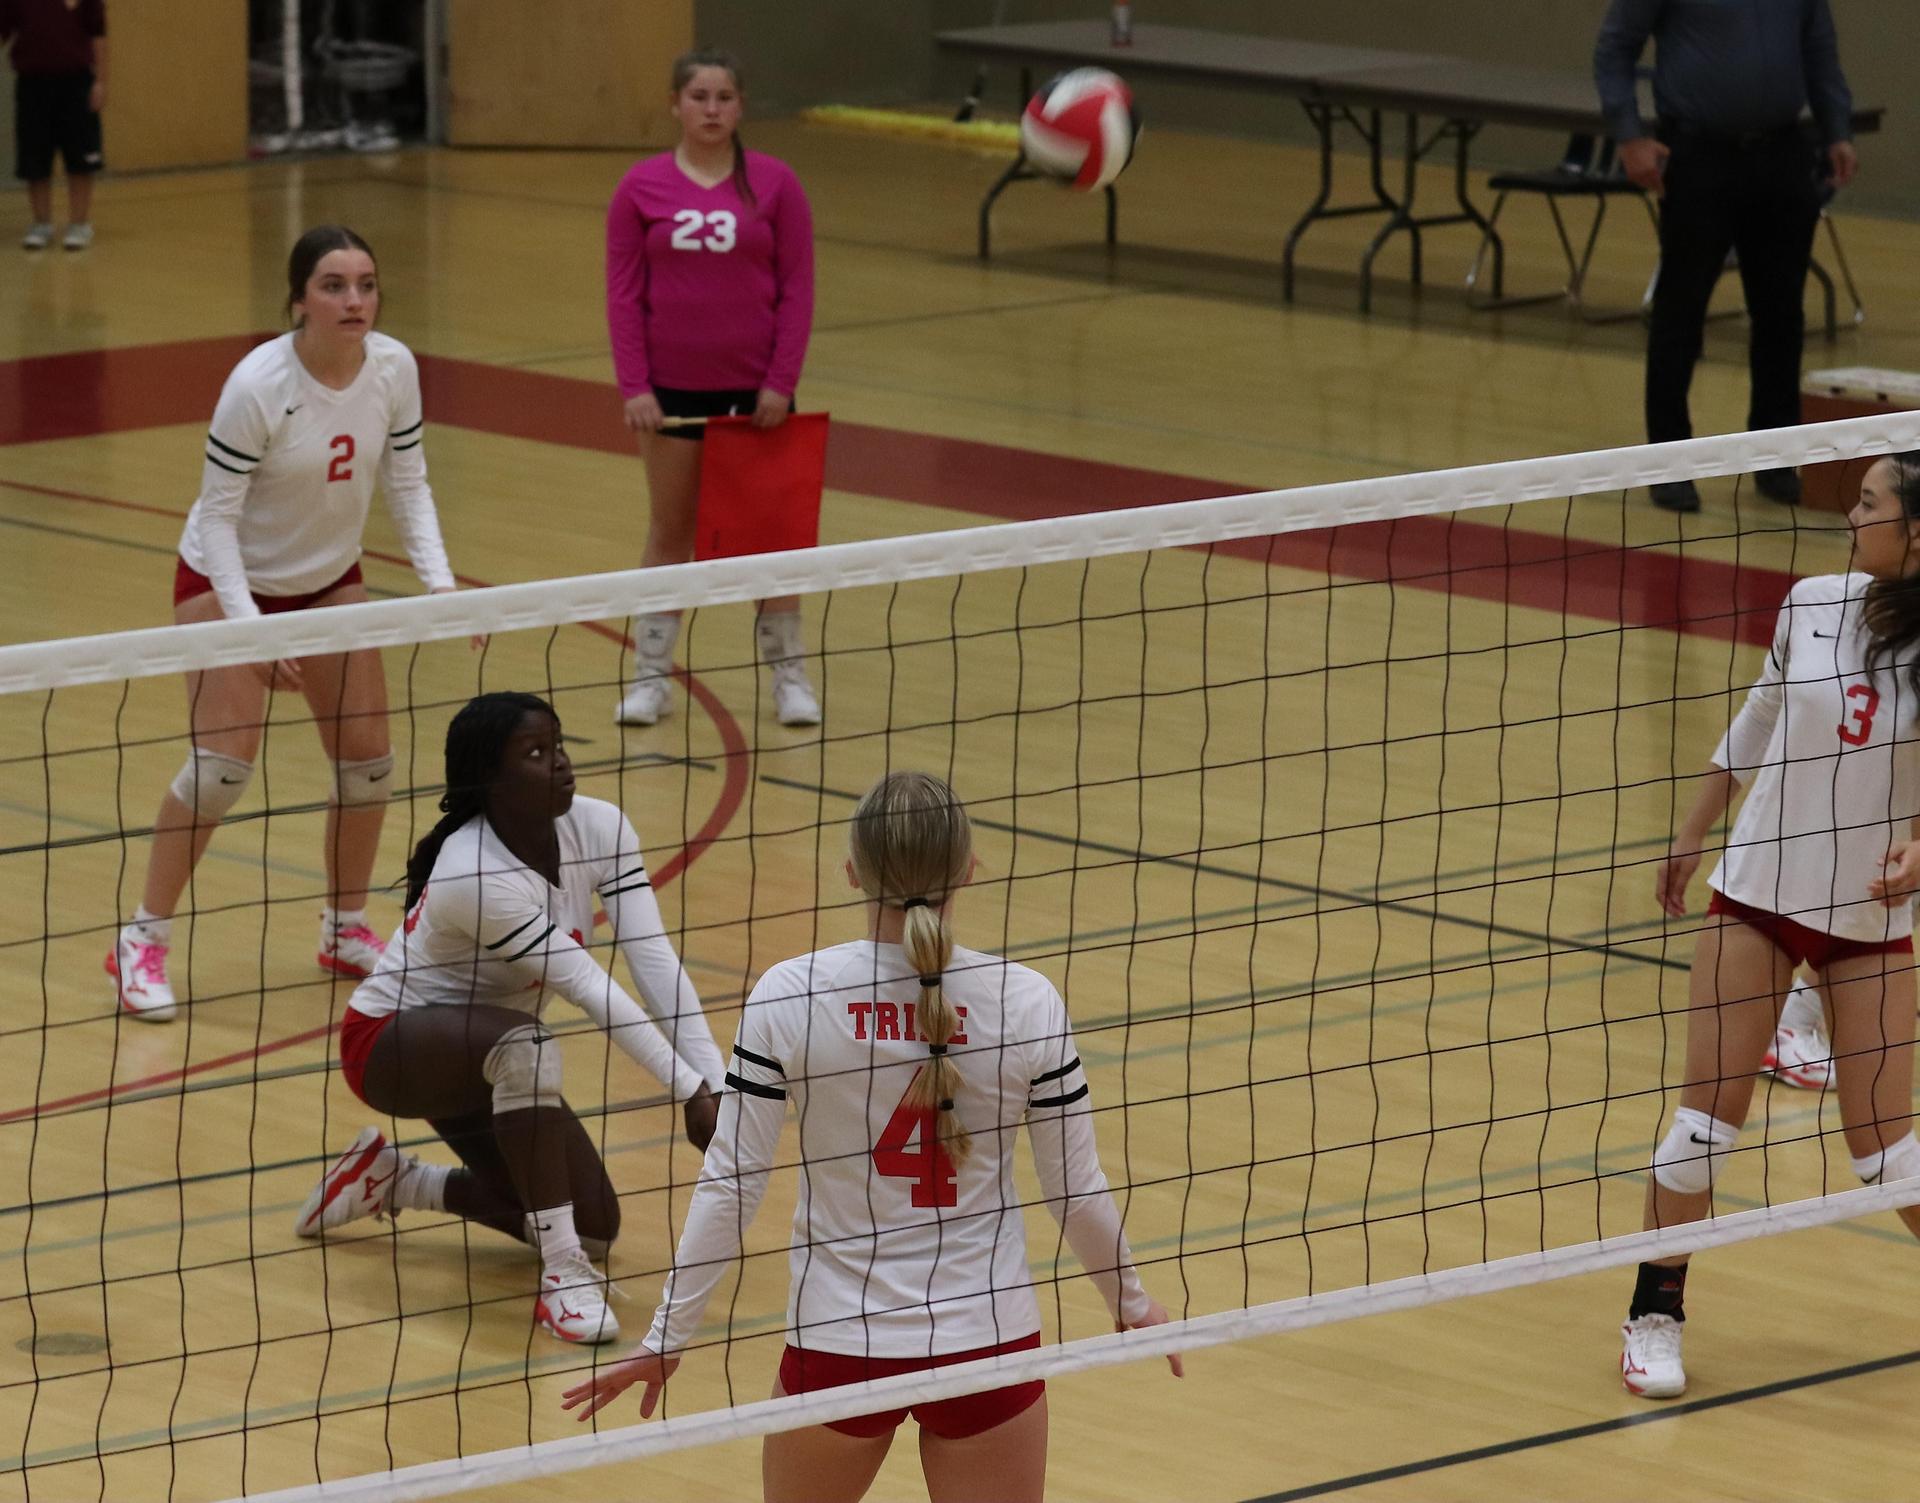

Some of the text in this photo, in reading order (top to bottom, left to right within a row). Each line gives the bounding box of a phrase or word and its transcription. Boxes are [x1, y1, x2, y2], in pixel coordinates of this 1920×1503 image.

[671, 208, 737, 253] 23
[327, 434, 355, 482] 2
[1837, 684, 1880, 747] 3
[847, 1002, 968, 1045] TRIE
[871, 1065, 958, 1208] 4
